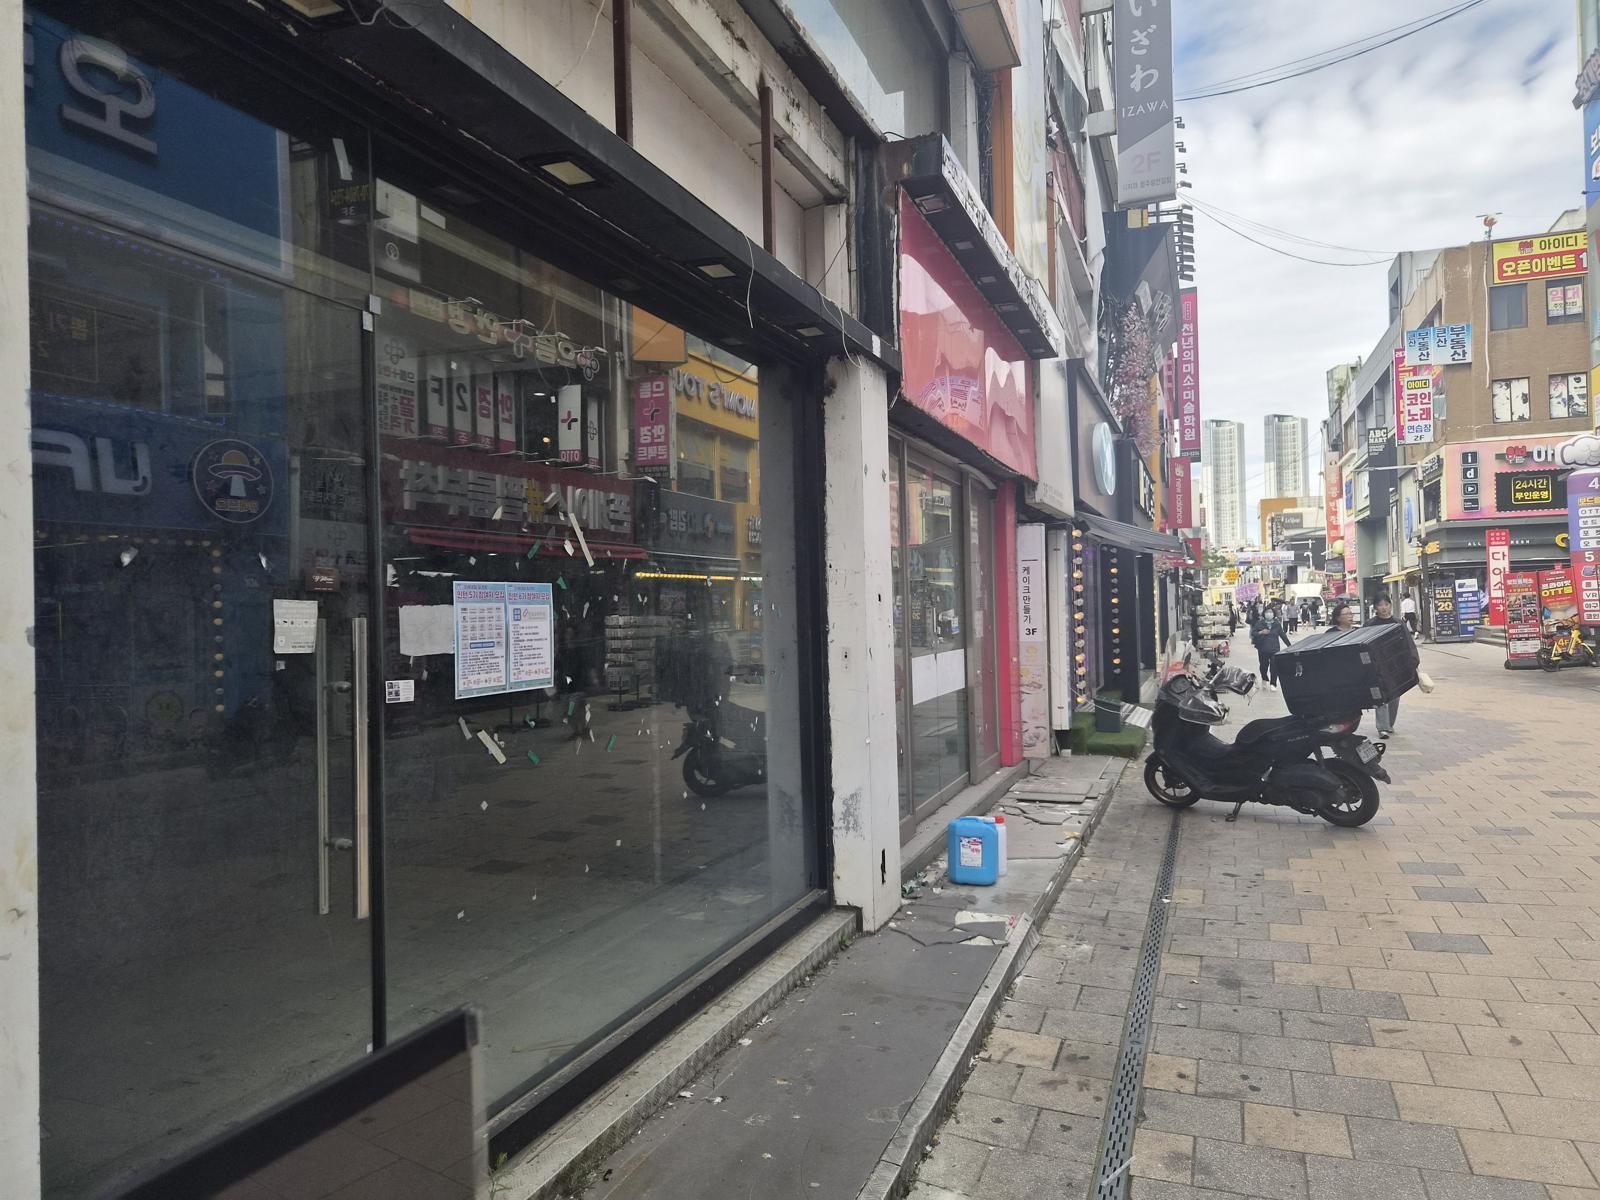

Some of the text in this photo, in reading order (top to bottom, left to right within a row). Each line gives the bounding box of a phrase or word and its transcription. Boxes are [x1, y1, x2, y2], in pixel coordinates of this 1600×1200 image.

[1121, 99, 1169, 118] IZAWA
[1132, 152, 1161, 175] 2F
[1539, 235, 1578, 251] 아이디
[1502, 254, 1577, 277] 오픈이벤트
[1417, 331, 1431, 362] 부동산
[1449, 325, 1468, 362] 부동산
[1406, 391, 1432, 406] 코인
[1407, 407, 1432, 422] 노래
[1368, 429, 1387, 438] ABC
[1407, 423, 1431, 433] 연습장
[1515, 479, 1548, 490] 24시간
[1175, 478, 1185, 524] new balance
[1515, 491, 1549, 500] 무인운영
[1022, 566, 1033, 625] 케이크만들기
[1025, 628, 1038, 637] 3F
